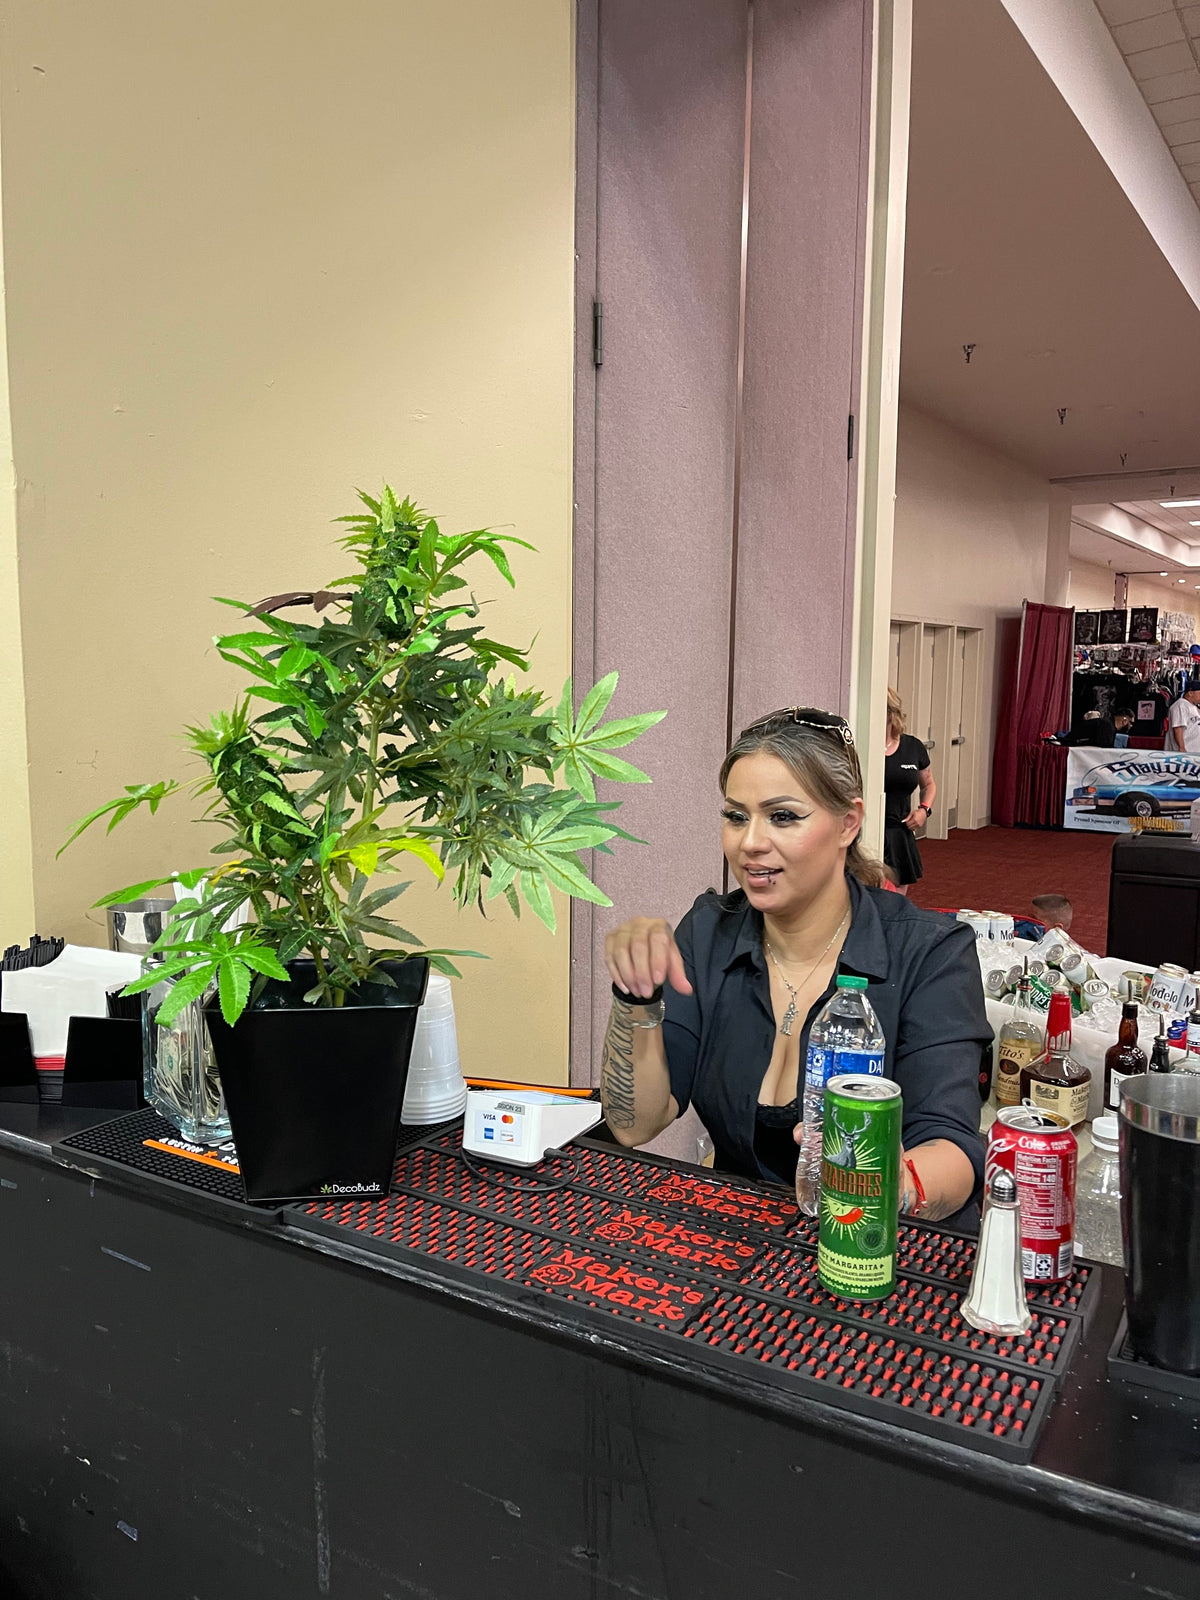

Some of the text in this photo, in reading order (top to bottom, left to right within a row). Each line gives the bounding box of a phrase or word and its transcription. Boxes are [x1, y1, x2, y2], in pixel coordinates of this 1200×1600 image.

[1150, 984, 1178, 1003] odelo
[999, 1045, 1025, 1060] Tito's
[483, 1113, 496, 1121] VISA
[1018, 1136, 1047, 1150] Coke
[1042, 1174, 1056, 1183] 140
[661, 1173, 799, 1215] Maker's
[688, 1193, 785, 1226] Mark
[610, 1209, 755, 1258] Maker's
[631, 1233, 741, 1271] Mark
[830, 1256, 878, 1271] MARGARITA
[550, 1249, 705, 1305] Maker's
[570, 1275, 686, 1321] Mark
